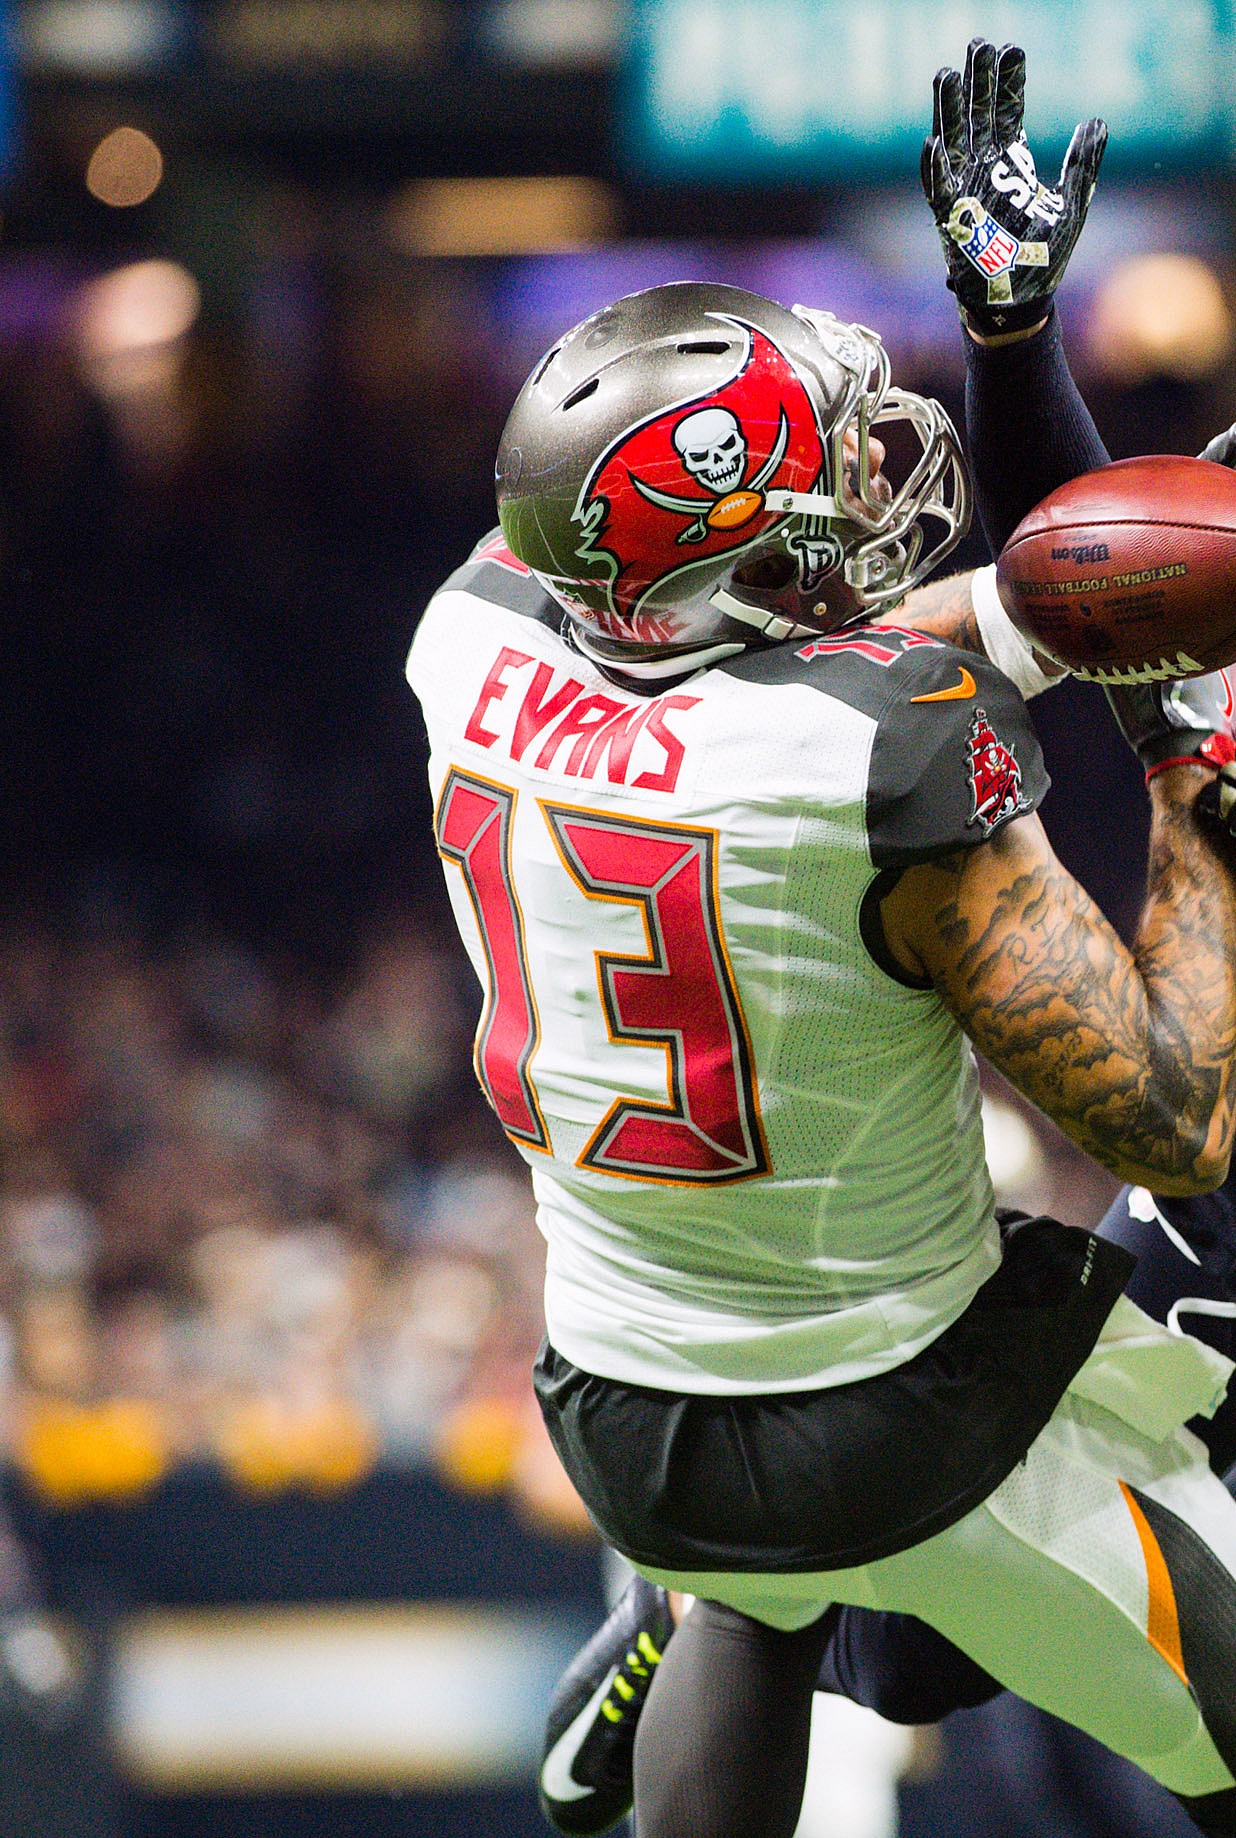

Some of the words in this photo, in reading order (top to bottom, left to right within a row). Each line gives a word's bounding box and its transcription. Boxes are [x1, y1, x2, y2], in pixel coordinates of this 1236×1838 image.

[978, 237, 1014, 273] NFL
[1051, 544, 1111, 564] Wilson
[1048, 576, 1108, 595] FOOTBALL
[1113, 563, 1187, 587] NATIONAL
[464, 646, 704, 793] EVANS
[434, 764, 773, 1188] 13
[1080, 1237, 1097, 1286] DRI-FIT
